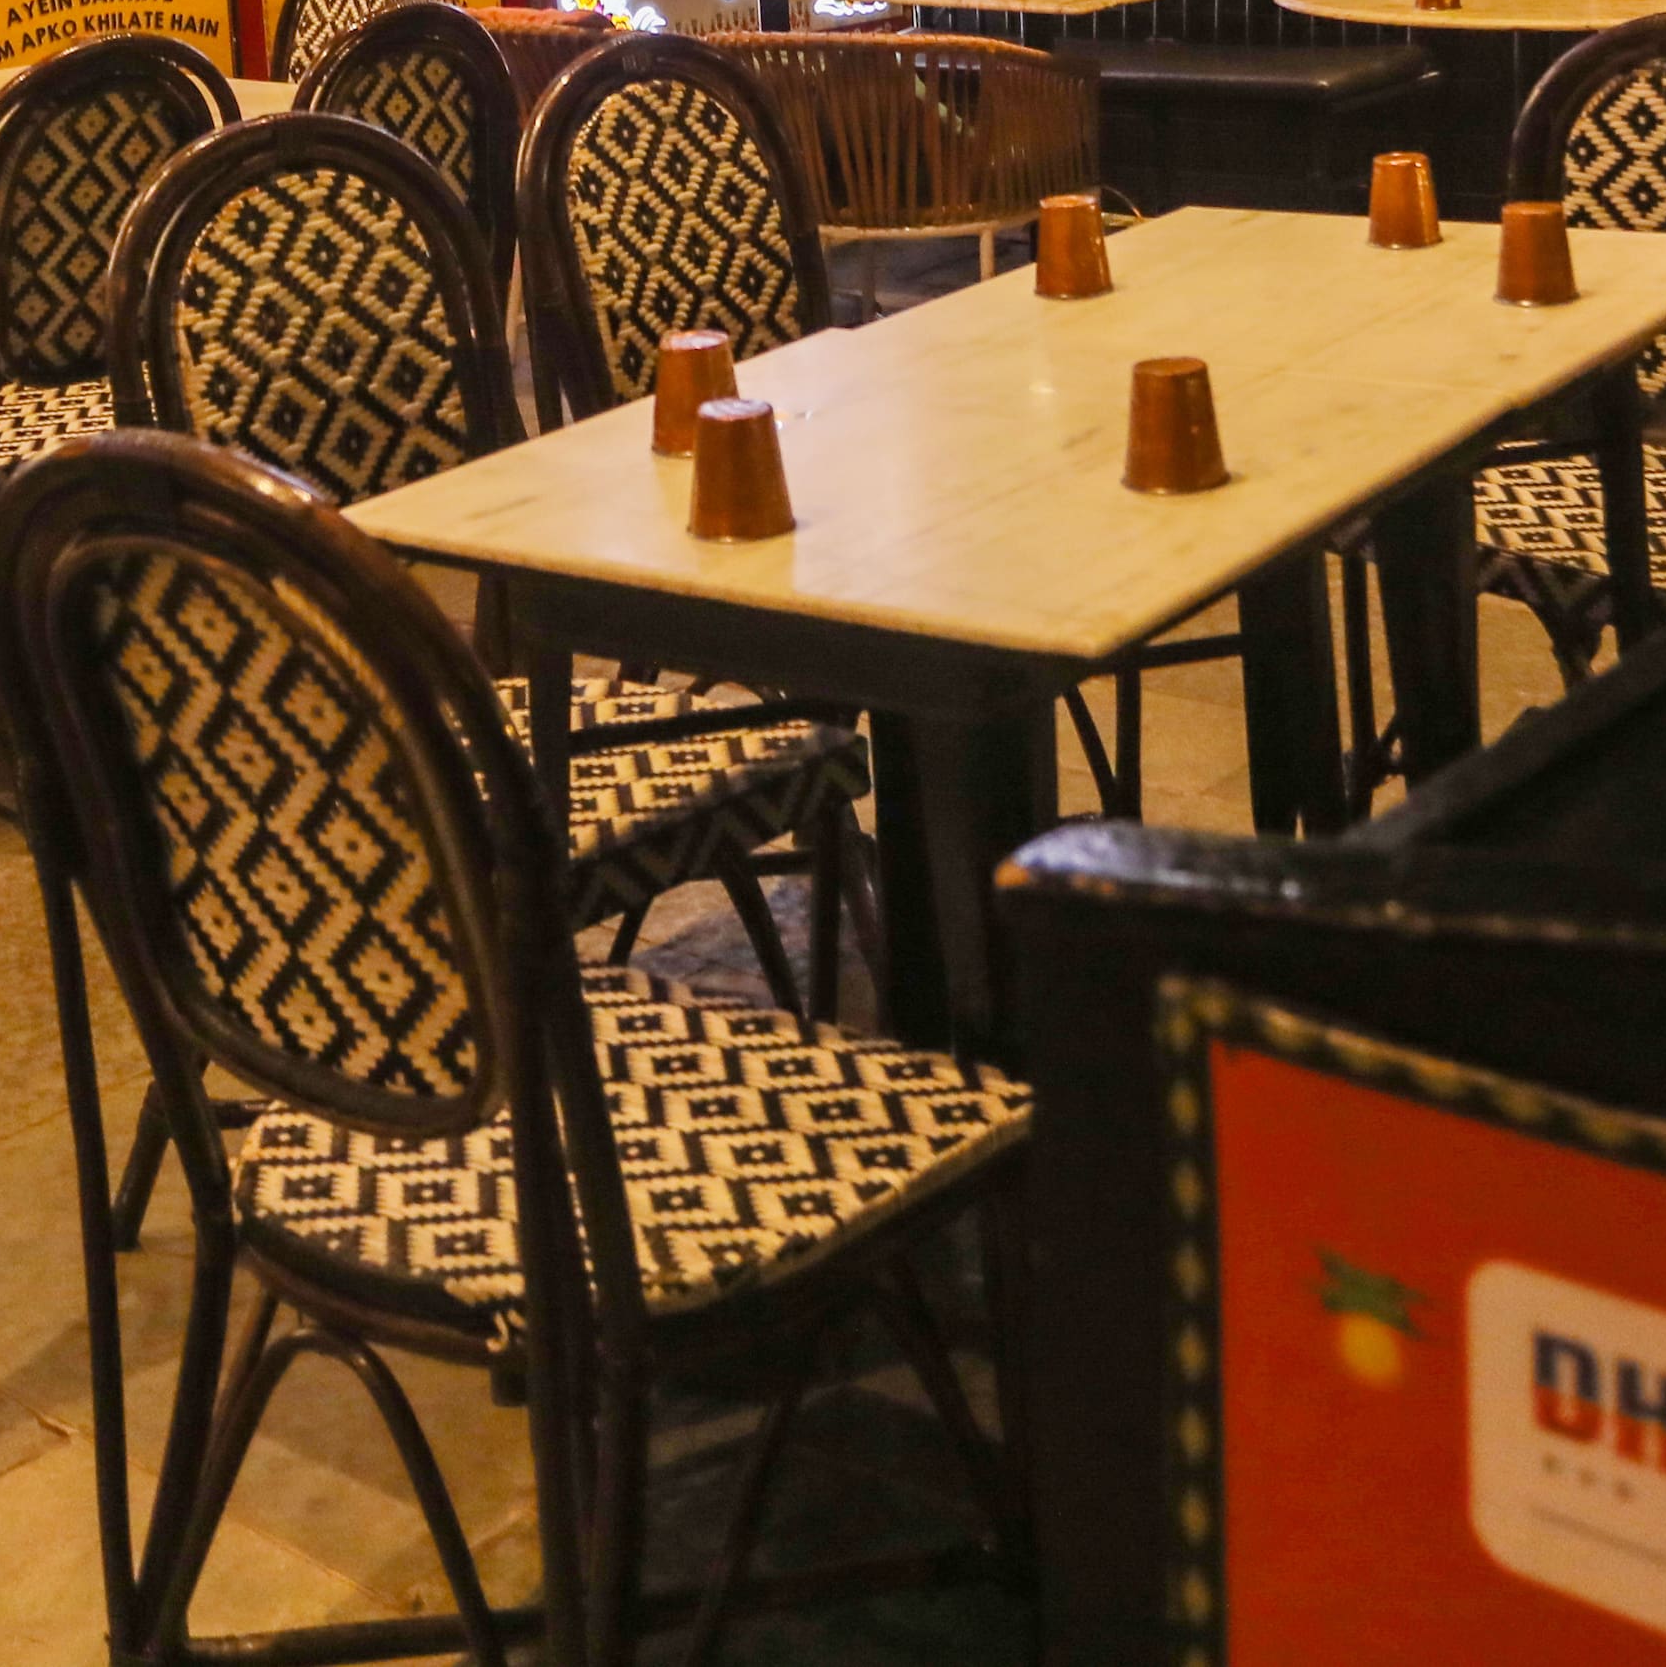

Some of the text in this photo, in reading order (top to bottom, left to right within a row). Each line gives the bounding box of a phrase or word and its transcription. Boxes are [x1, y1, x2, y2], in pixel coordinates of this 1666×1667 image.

[21, 19, 78, 53] APKO
[83, 11, 164, 36] KHILATE
[170, 13, 220, 38] HAIN
